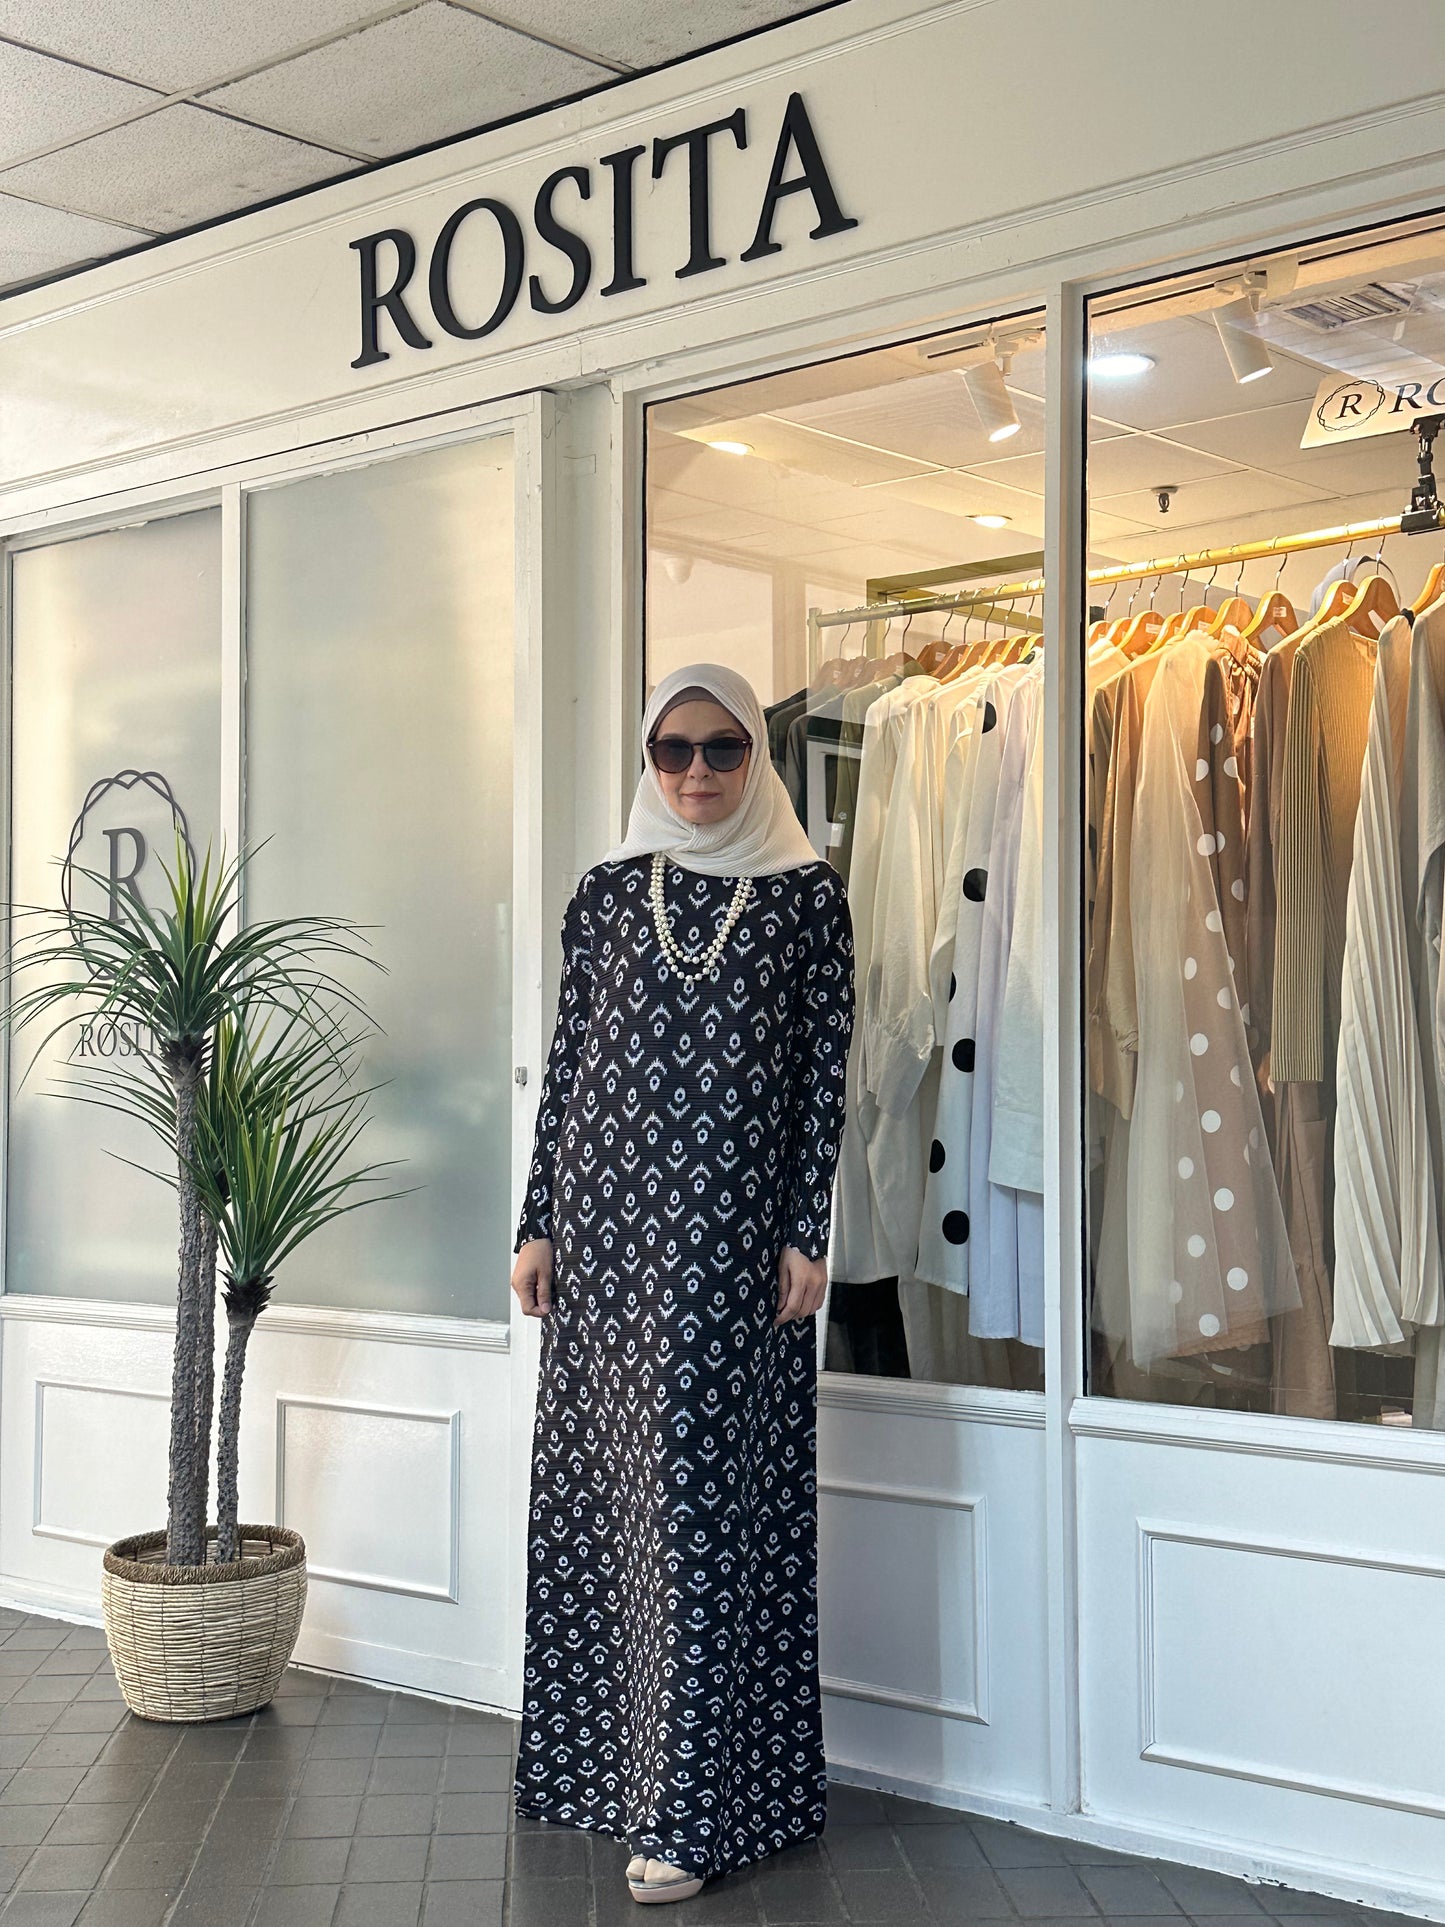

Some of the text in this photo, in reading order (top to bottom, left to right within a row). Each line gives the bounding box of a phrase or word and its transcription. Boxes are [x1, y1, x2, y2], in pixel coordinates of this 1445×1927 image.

[349, 91, 858, 369] ROSITA
[1335, 393, 1363, 419] R
[102, 827, 150, 925] R
[79, 1022, 156, 1057] ROSIT
